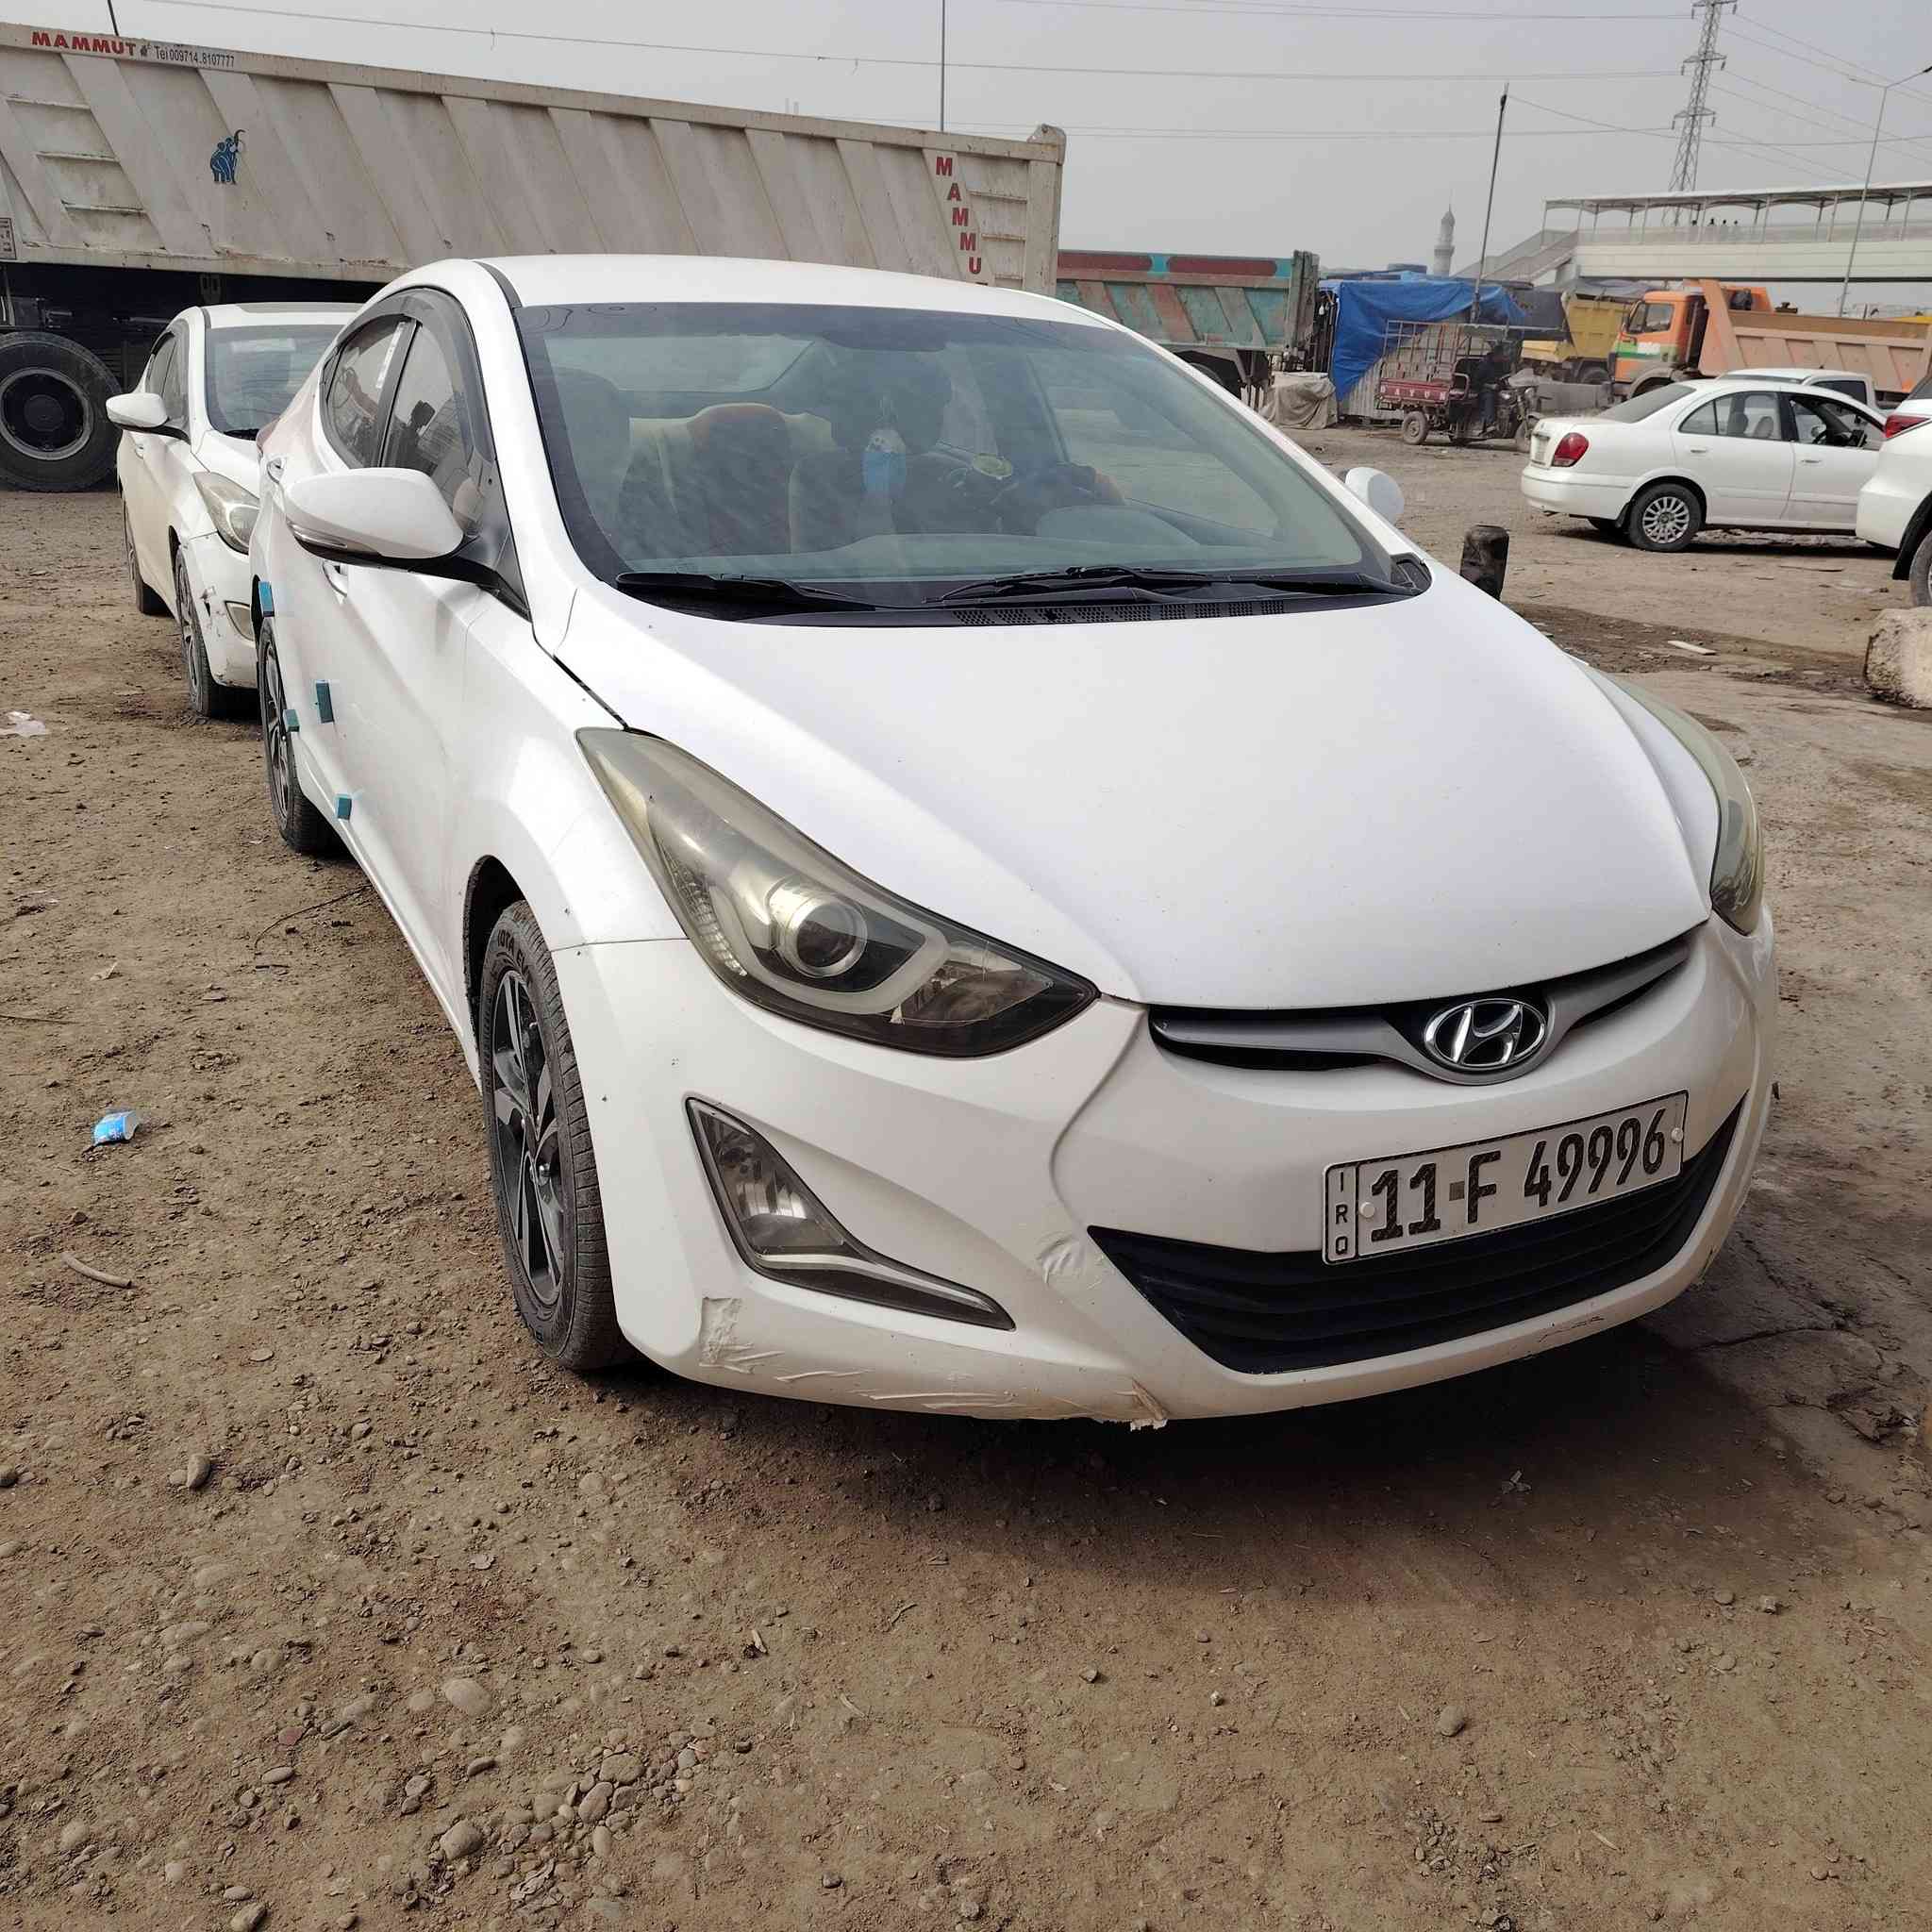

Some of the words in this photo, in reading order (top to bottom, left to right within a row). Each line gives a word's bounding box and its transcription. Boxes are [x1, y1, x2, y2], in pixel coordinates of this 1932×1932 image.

[32, 31, 137, 57] MAMMUT
[935, 157, 989, 286] MAMMU
[1335, 1172, 1349, 1256] IRQ
[1371, 1161, 1441, 1242] 11
[1467, 1150, 1502, 1224] F
[1524, 1108, 1667, 1208] 49996
